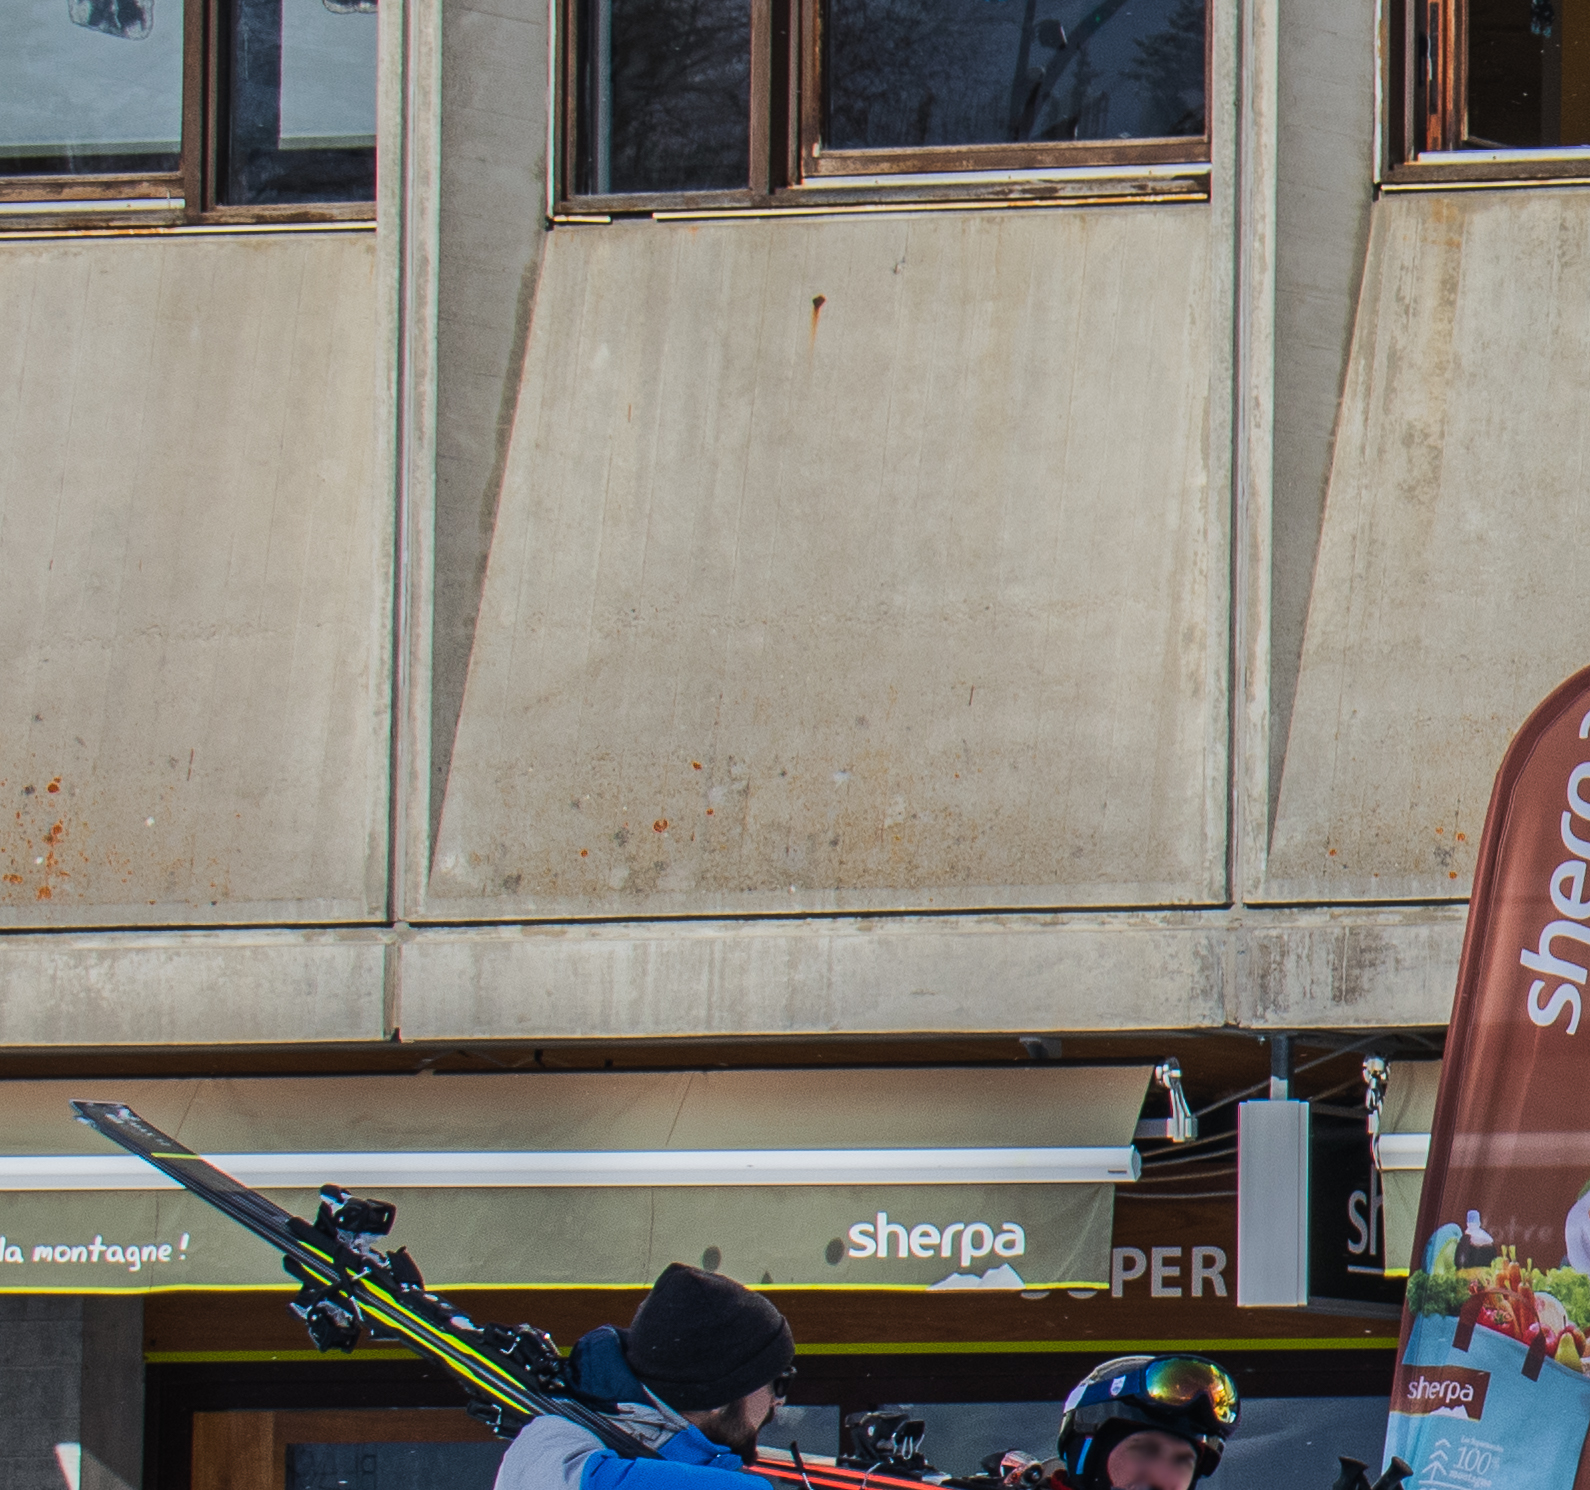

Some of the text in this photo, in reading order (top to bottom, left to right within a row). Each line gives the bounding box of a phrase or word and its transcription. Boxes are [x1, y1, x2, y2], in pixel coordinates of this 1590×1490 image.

[0, 1236, 23, 1263] la
[32, 1235, 172, 1272] montagne
[848, 1211, 1025, 1267] sherpa
[1407, 1376, 1474, 1404] sherpa
